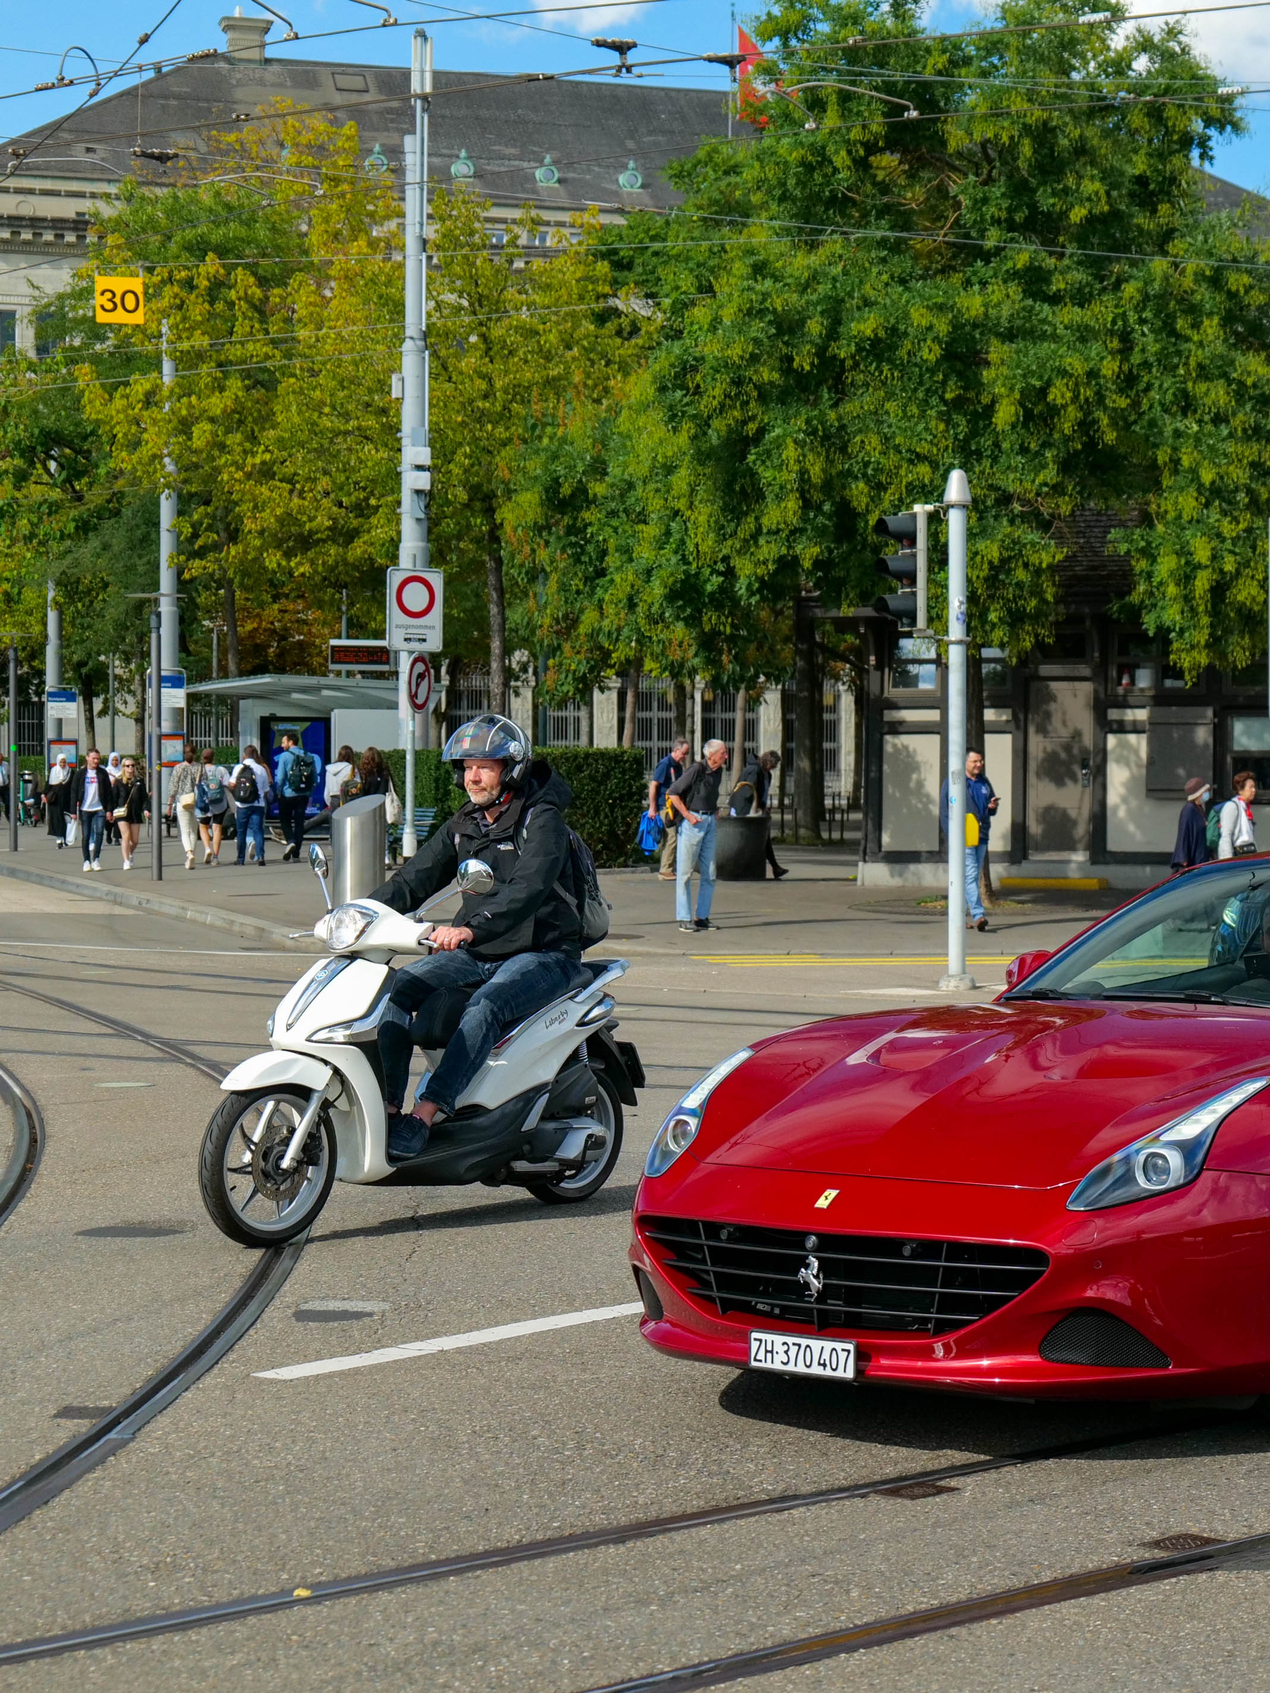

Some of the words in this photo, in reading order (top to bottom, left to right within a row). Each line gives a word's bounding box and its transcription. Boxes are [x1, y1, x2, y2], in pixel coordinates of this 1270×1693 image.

[99, 288, 140, 314] 30
[394, 623, 435, 631] ausgenommen
[544, 1008, 569, 1029] Liberty
